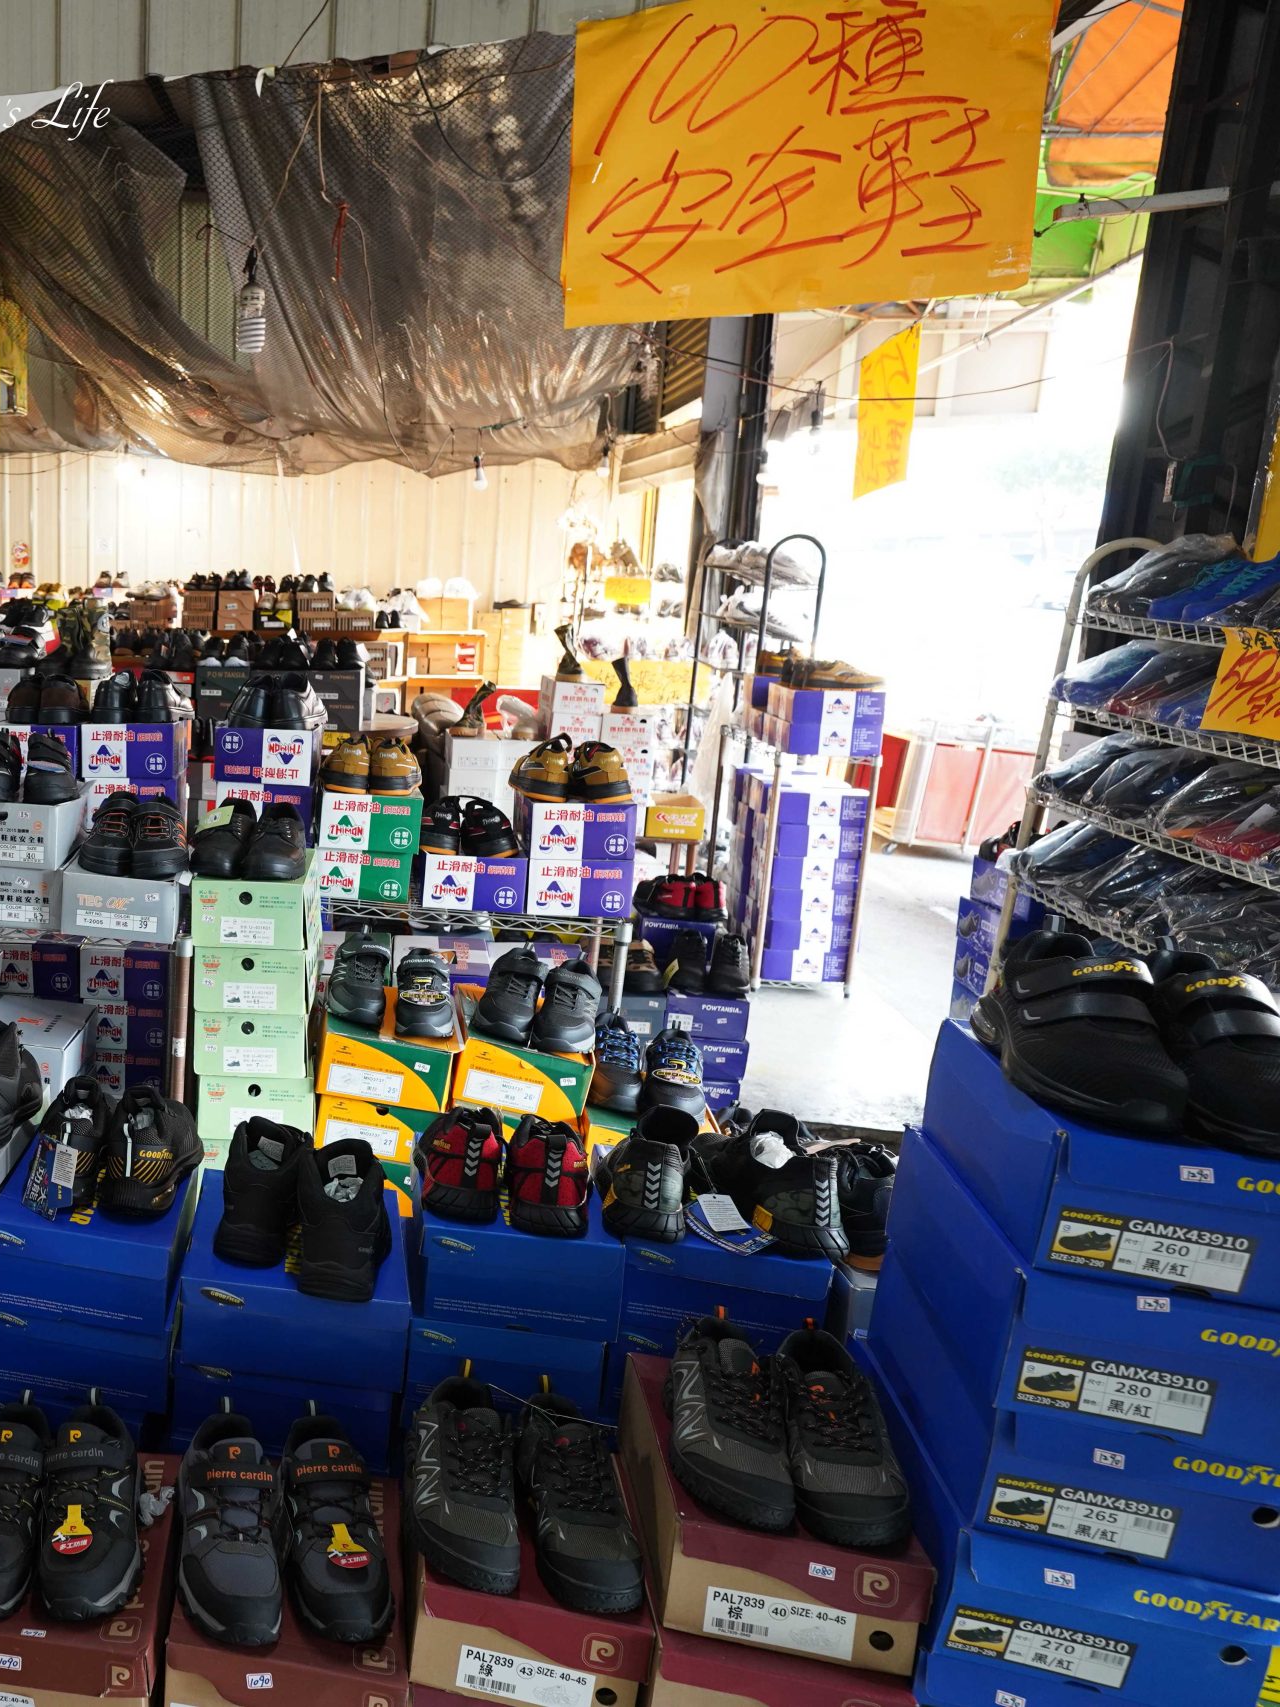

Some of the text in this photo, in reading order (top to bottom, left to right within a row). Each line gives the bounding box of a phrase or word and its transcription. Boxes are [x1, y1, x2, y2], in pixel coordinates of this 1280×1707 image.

[91, 730, 135, 742] 止滑耐油
[332, 800, 381, 814] 止滑耐油
[543, 809, 594, 822] 止滑耐油
[324, 851, 371, 865] 止滑耐油
[437, 860, 486, 874] 止滑耐油
[541, 866, 591, 878] 止滑耐油
[77, 893, 103, 907] TEC
[702, 1004, 742, 1014] POWTANSIA
[1061, 1208, 1250, 1251] GOODYEAR GAMX43910
[1152, 1240, 1191, 1258] 260
[1141, 1258, 1189, 1278] 黑/紅
[1025, 1350, 1209, 1392] GOODYEAR GAMX43910
[1114, 1381, 1152, 1399] 280
[1106, 1399, 1152, 1419] 黑/紅
[11, 1453, 39, 1467] cardin
[70, 1447, 104, 1459] cardin
[296, 1460, 363, 1477] pierre cardin
[206, 1470, 274, 1482] pierre cardin
[998, 1477, 1173, 1520] GOODYEAR GAMX43910
[1082, 1507, 1119, 1524] 265
[1074, 1523, 1118, 1543] 黑/紅
[811, 1565, 834, 1577] 1080
[712, 1590, 766, 1611] PAL7839
[772, 1606, 787, 1618] 40
[790, 1605, 814, 1619] SIZE:
[1133, 1589, 1279, 1633] GOODYEAR
[958, 1607, 1129, 1653] GOODYEAR GAMX43910
[1041, 1638, 1076, 1655] 270
[0, 1657, 19, 1669] 1090
[465, 1648, 514, 1670] PAL7839
[1030, 1652, 1074, 1672] 黑/紅
[520, 1665, 534, 1676] 43
[536, 1666, 558, 1679] SIZE:
[249, 1675, 271, 1688] 1090
